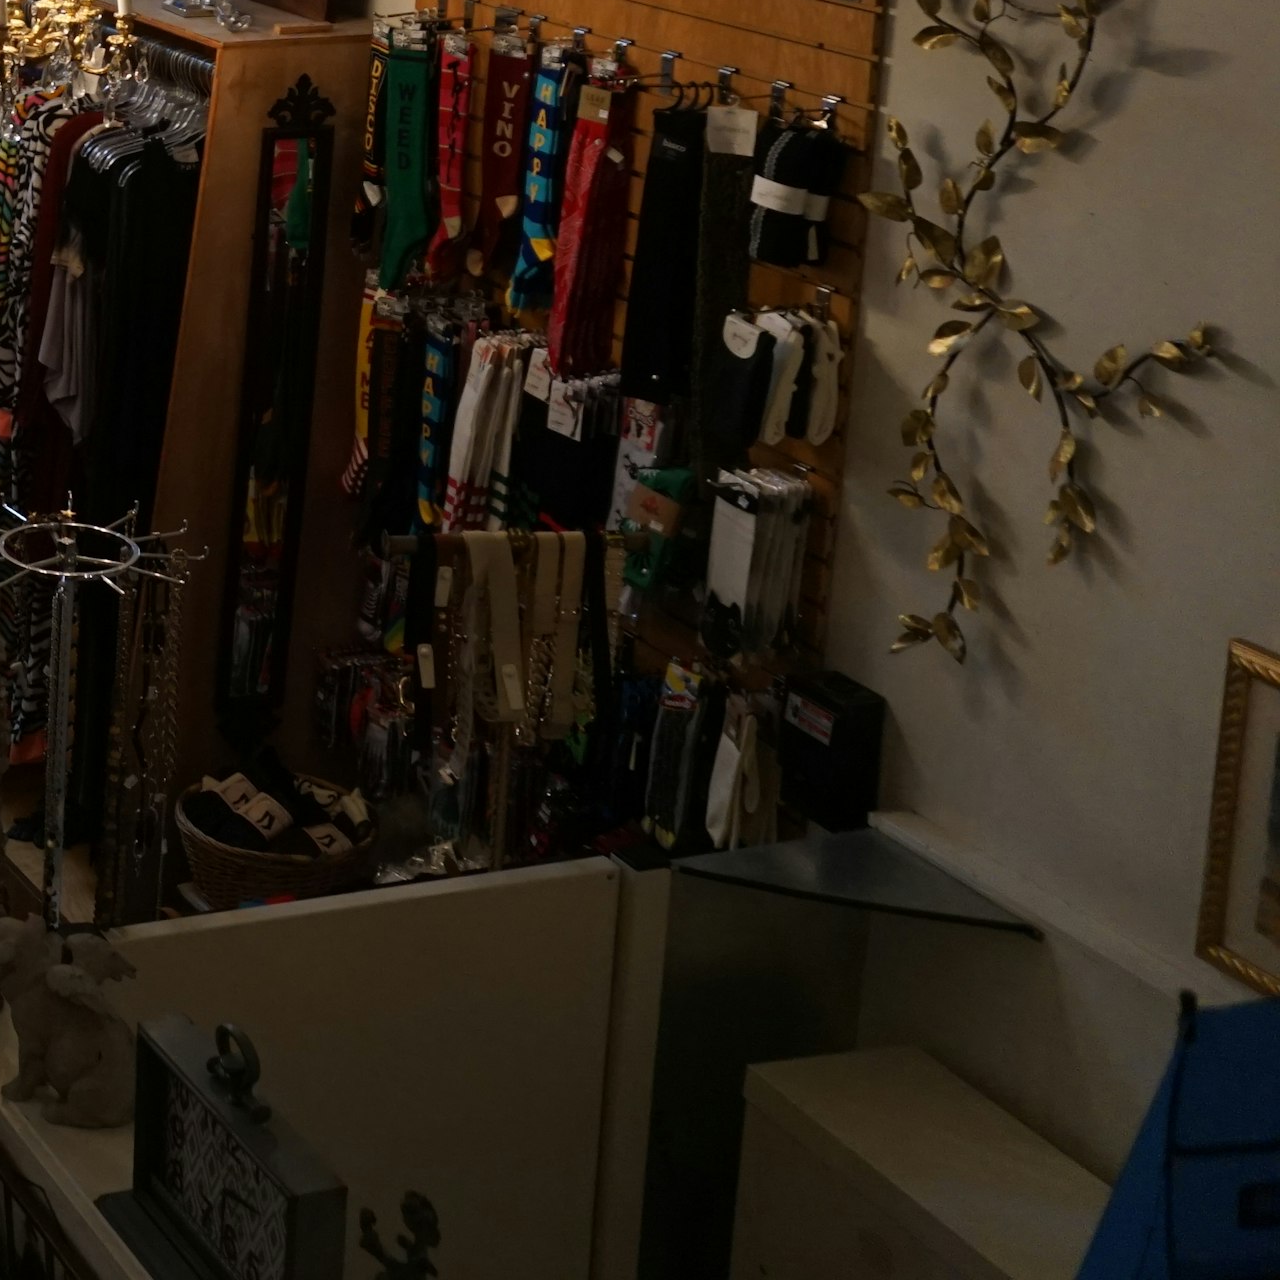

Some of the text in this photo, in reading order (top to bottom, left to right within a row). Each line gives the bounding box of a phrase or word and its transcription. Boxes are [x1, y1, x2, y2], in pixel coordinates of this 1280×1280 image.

[365, 58, 383, 151] DISCO
[397, 81, 417, 170] WEED
[492, 80, 520, 158] VINO
[528, 82, 552, 204] HAPPY
[420, 352, 440, 463] HAPPY
